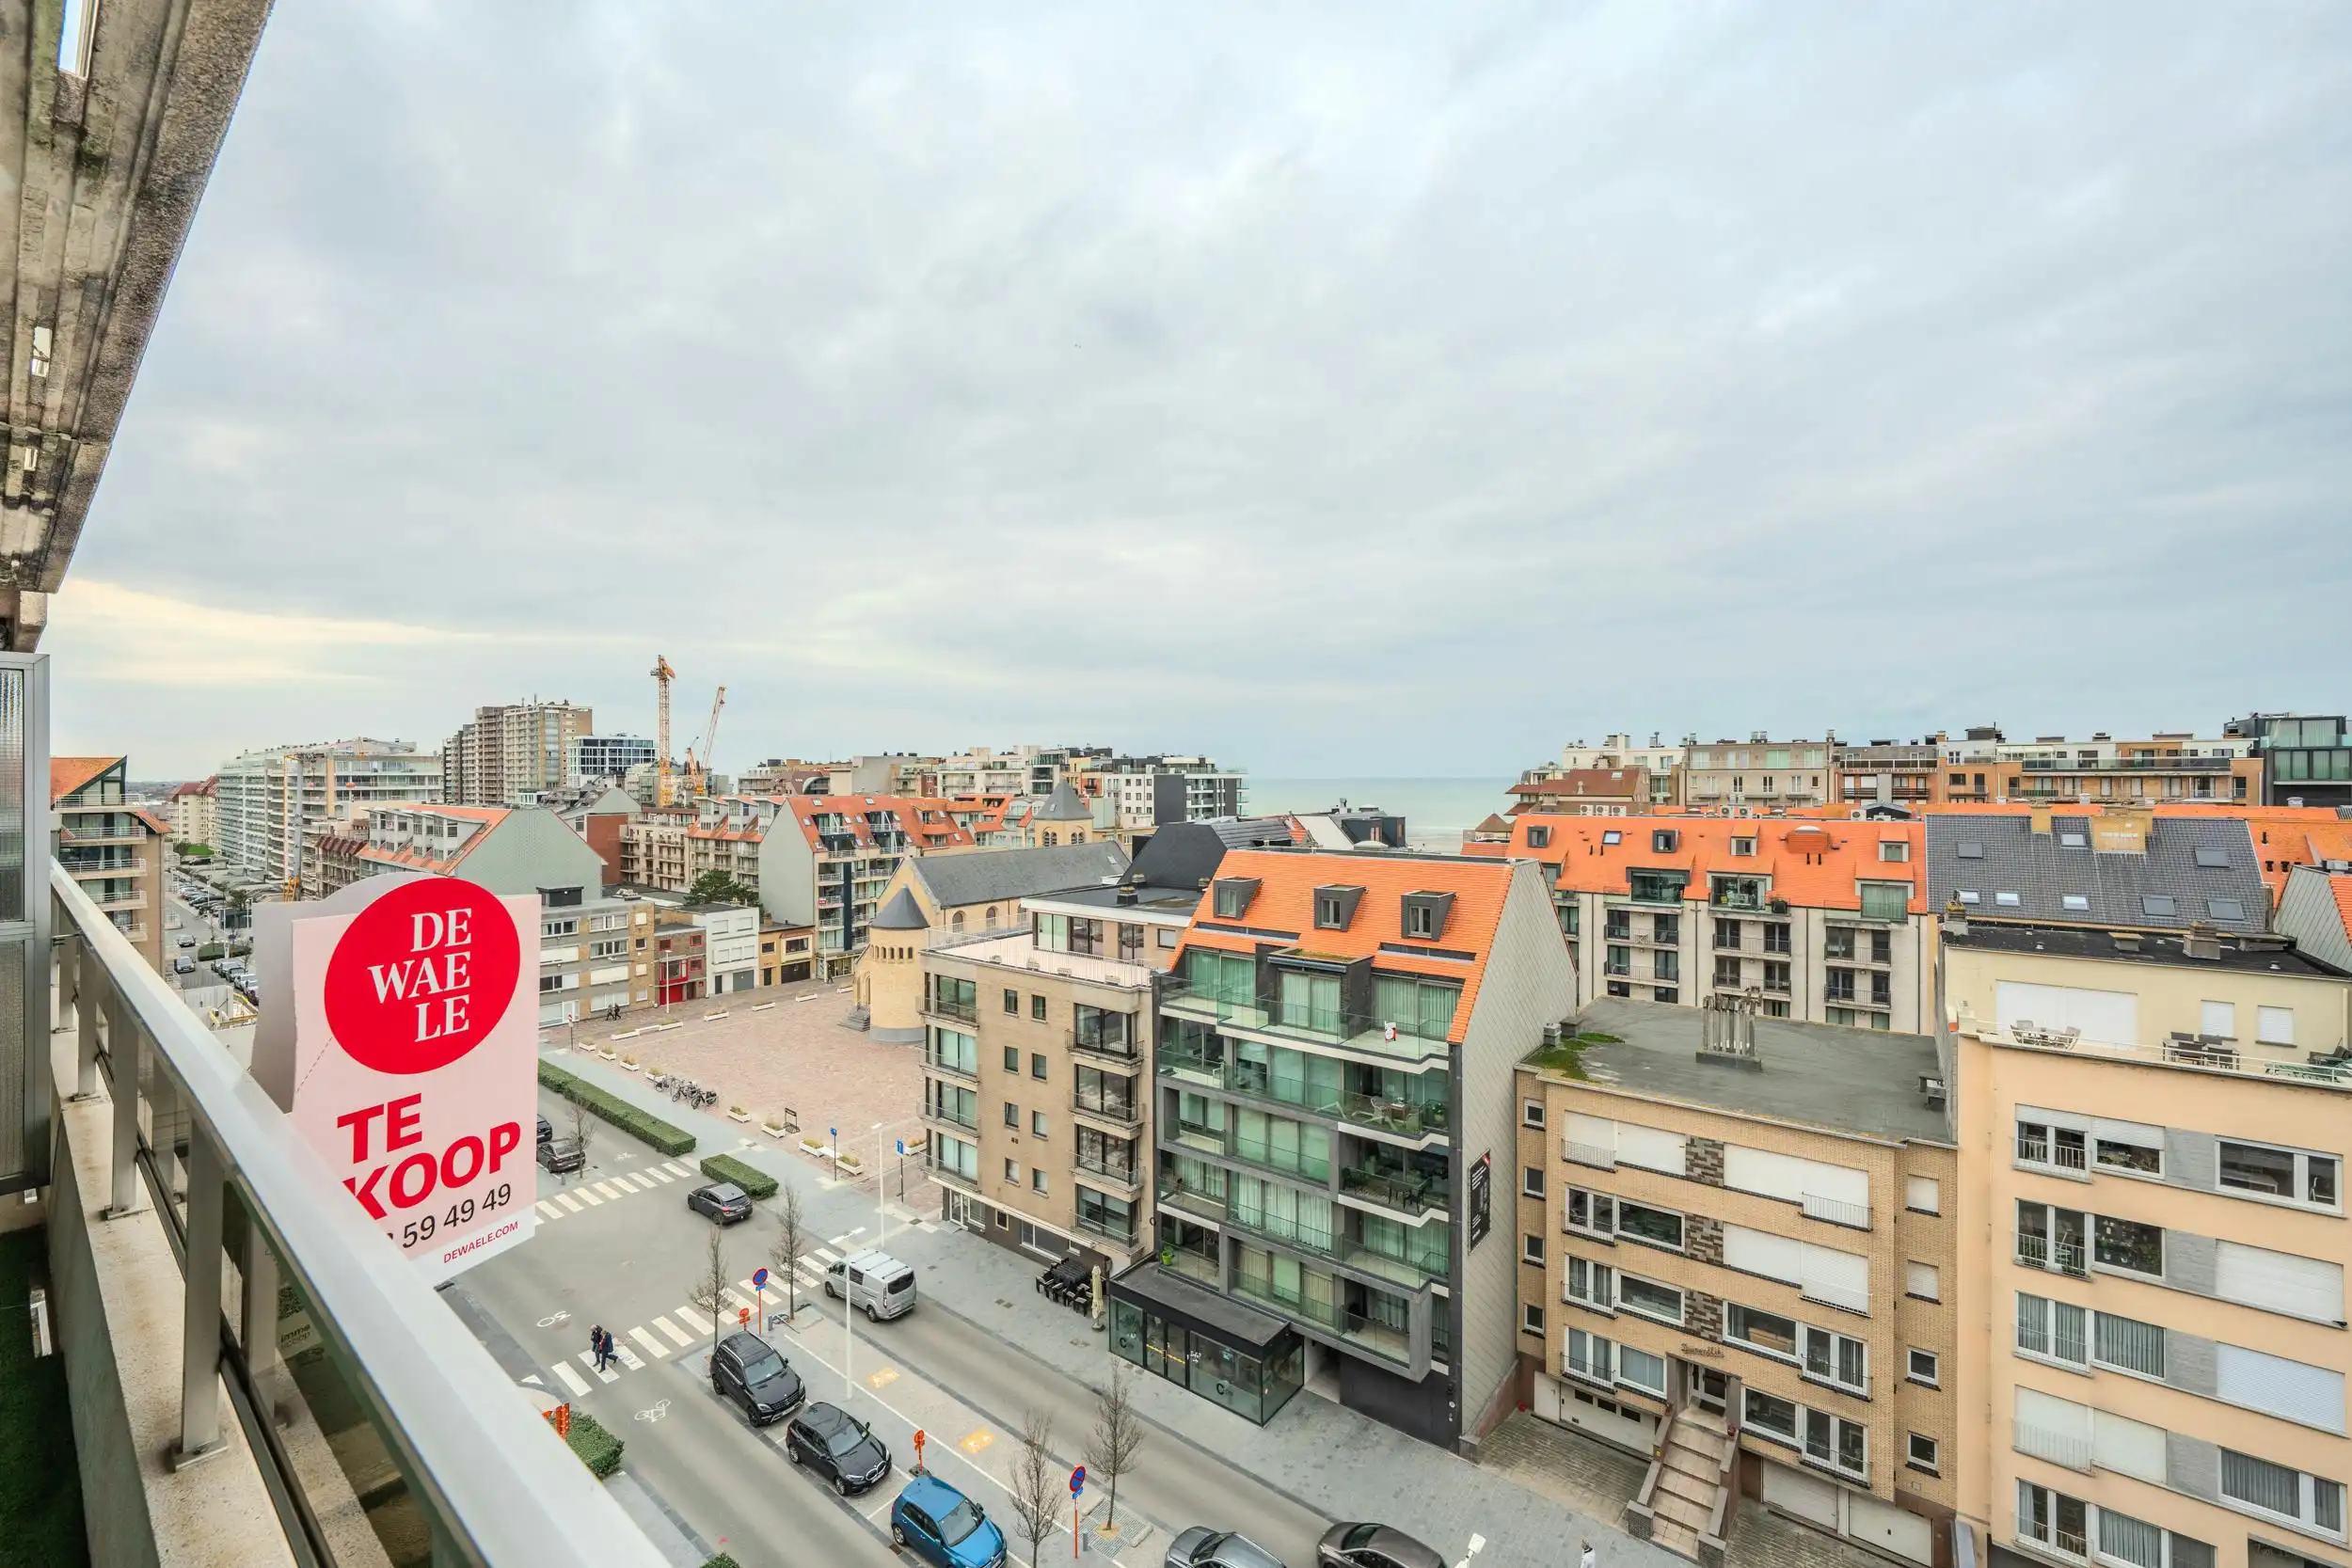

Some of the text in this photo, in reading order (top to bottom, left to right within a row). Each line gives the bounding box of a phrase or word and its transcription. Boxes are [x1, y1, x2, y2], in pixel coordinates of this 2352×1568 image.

[411, 908, 471, 952] DE
[368, 951, 470, 1004] WAE
[415, 994, 470, 1042] LE
[337, 1093, 421, 1164] TE
[342, 1122, 521, 1220] KOOP
[402, 1183, 511, 1248] 59 49 49
[443, 1221, 518, 1263] DEWAELE.COM
